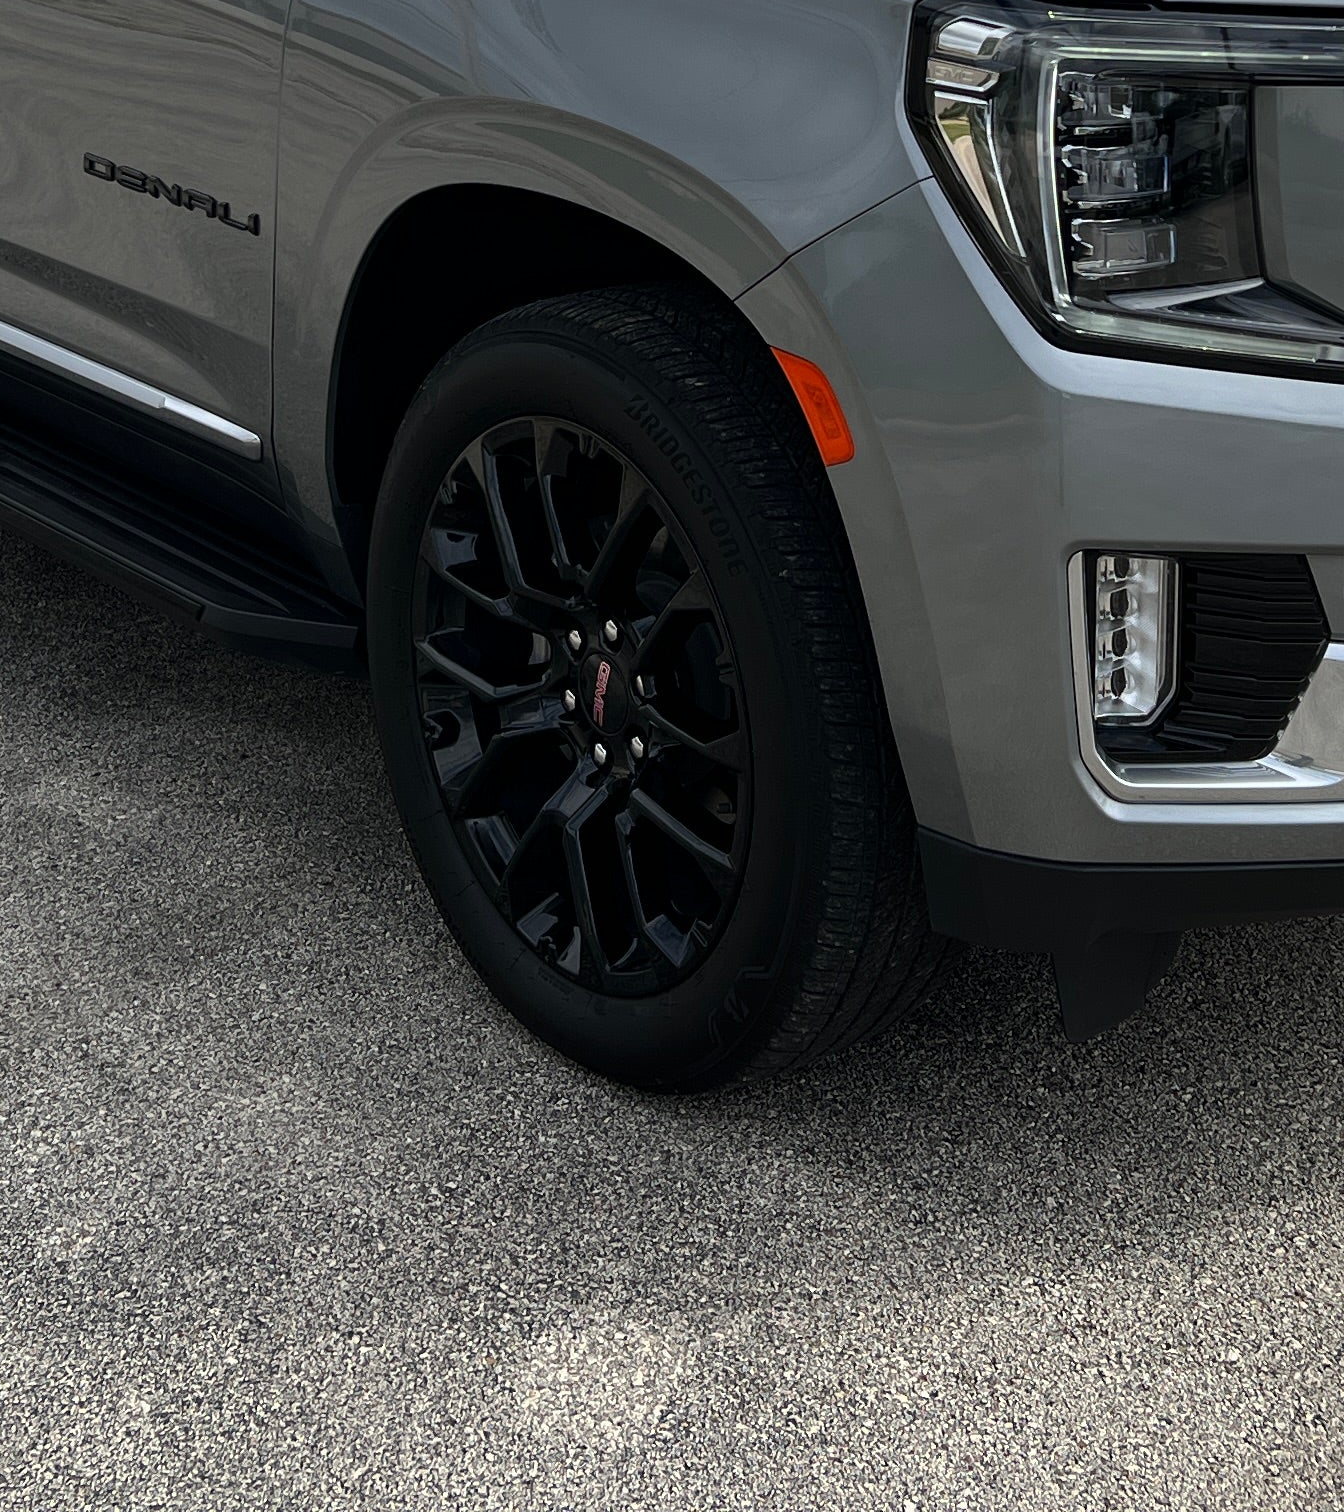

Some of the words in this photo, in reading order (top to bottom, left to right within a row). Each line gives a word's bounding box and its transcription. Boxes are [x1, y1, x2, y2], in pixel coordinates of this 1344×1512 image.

[83, 151, 261, 237] DENALI
[623, 393, 749, 578] BRIDGESTONE
[593, 660, 611, 728] GMC
